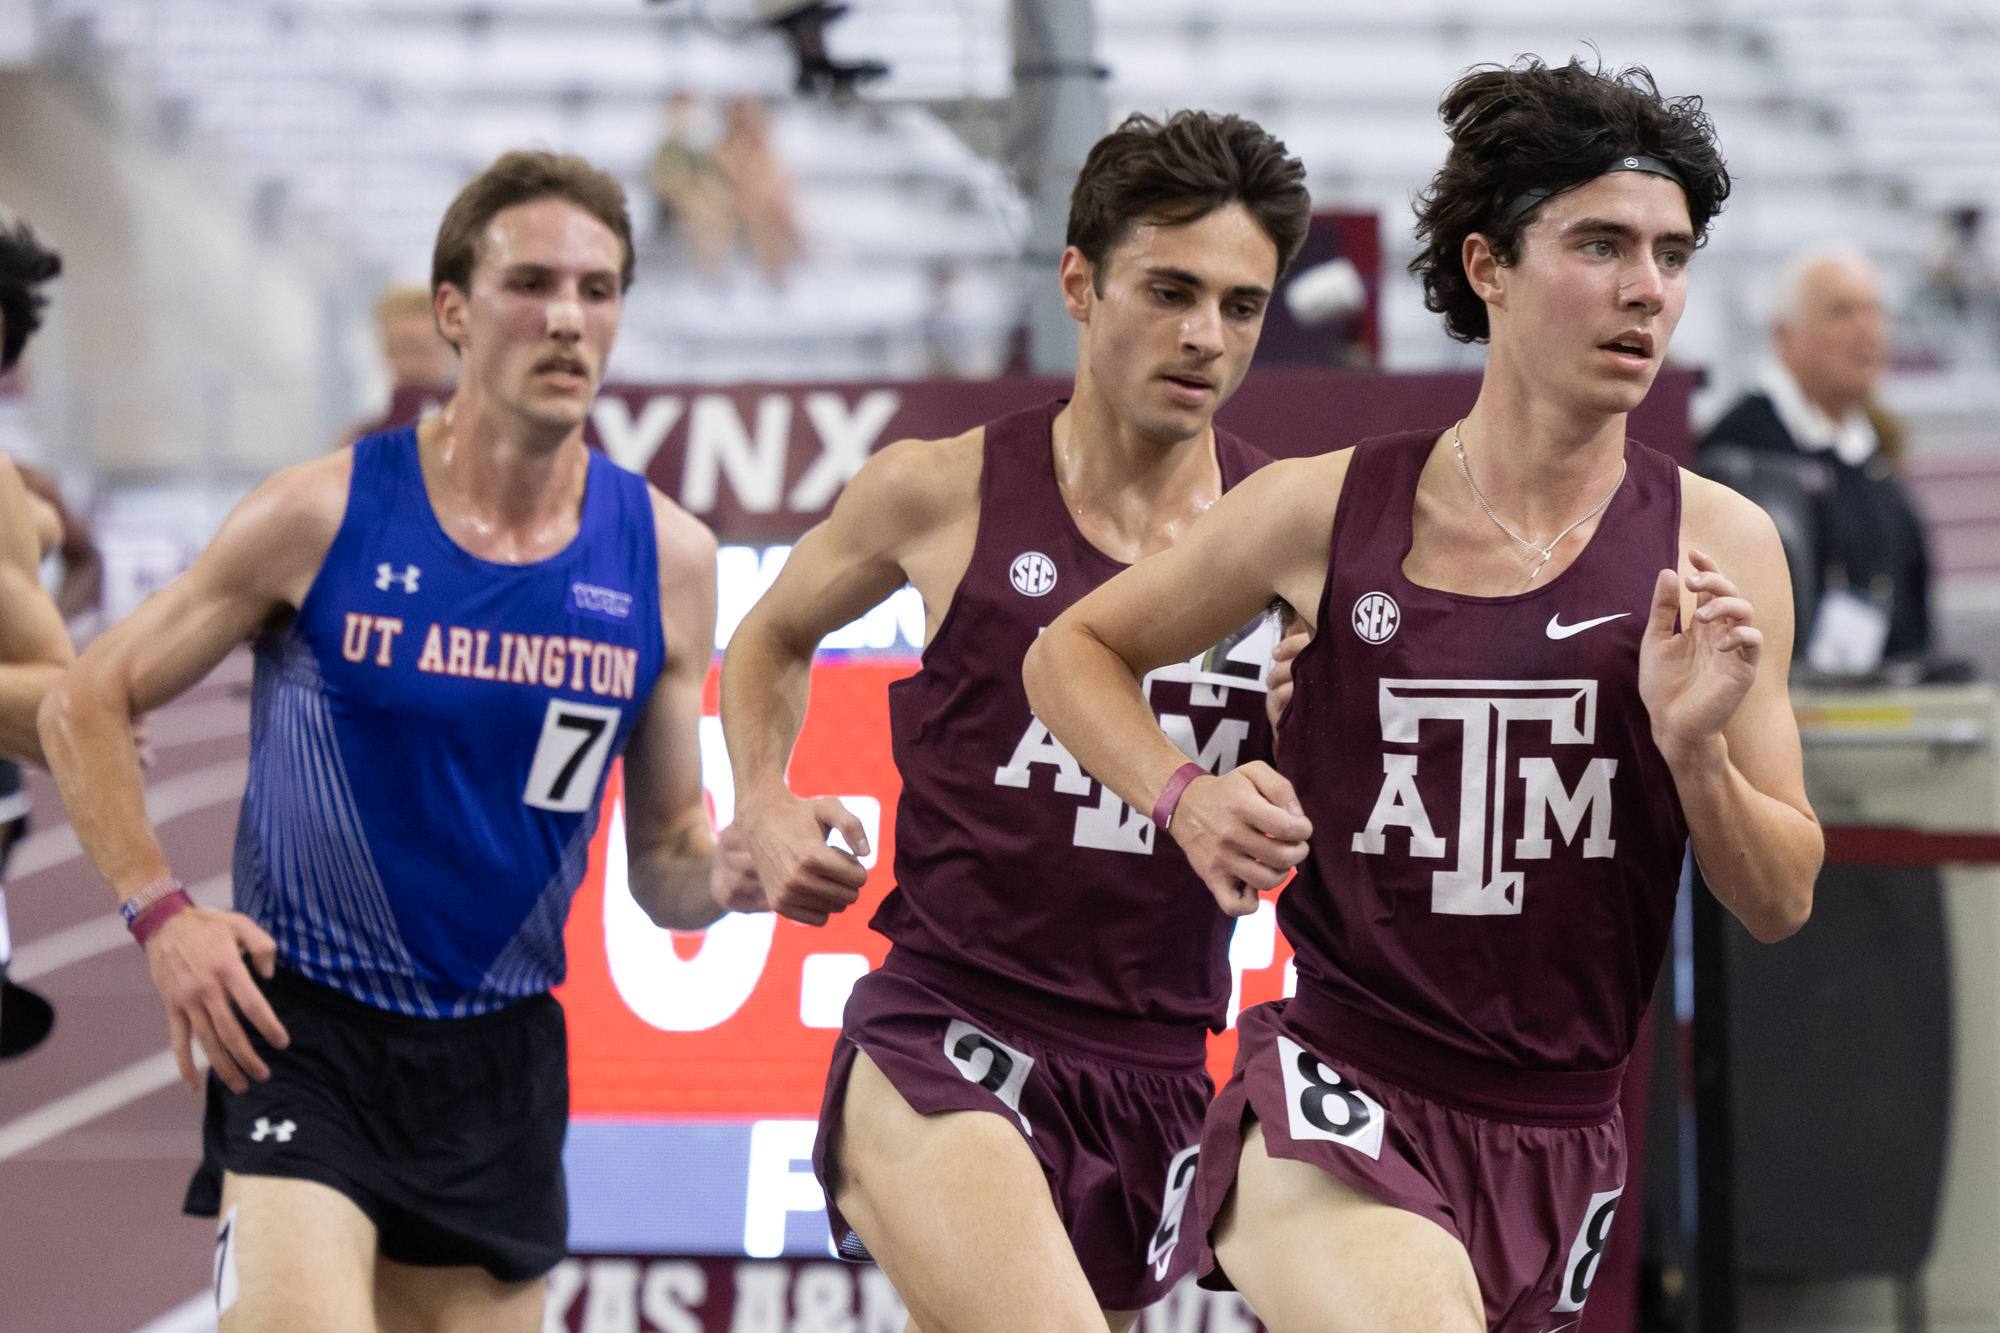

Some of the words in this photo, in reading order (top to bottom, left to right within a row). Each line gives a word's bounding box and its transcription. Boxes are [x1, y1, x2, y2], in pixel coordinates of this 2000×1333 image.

[1014, 554, 1054, 594] SEC
[342, 611, 404, 668] UT
[416, 622, 639, 700] ARLINGTON
[1357, 596, 1397, 641] SEC
[547, 713, 608, 803] 7
[1297, 1051, 1371, 1138] 8
[1570, 1194, 1622, 1304] 8
